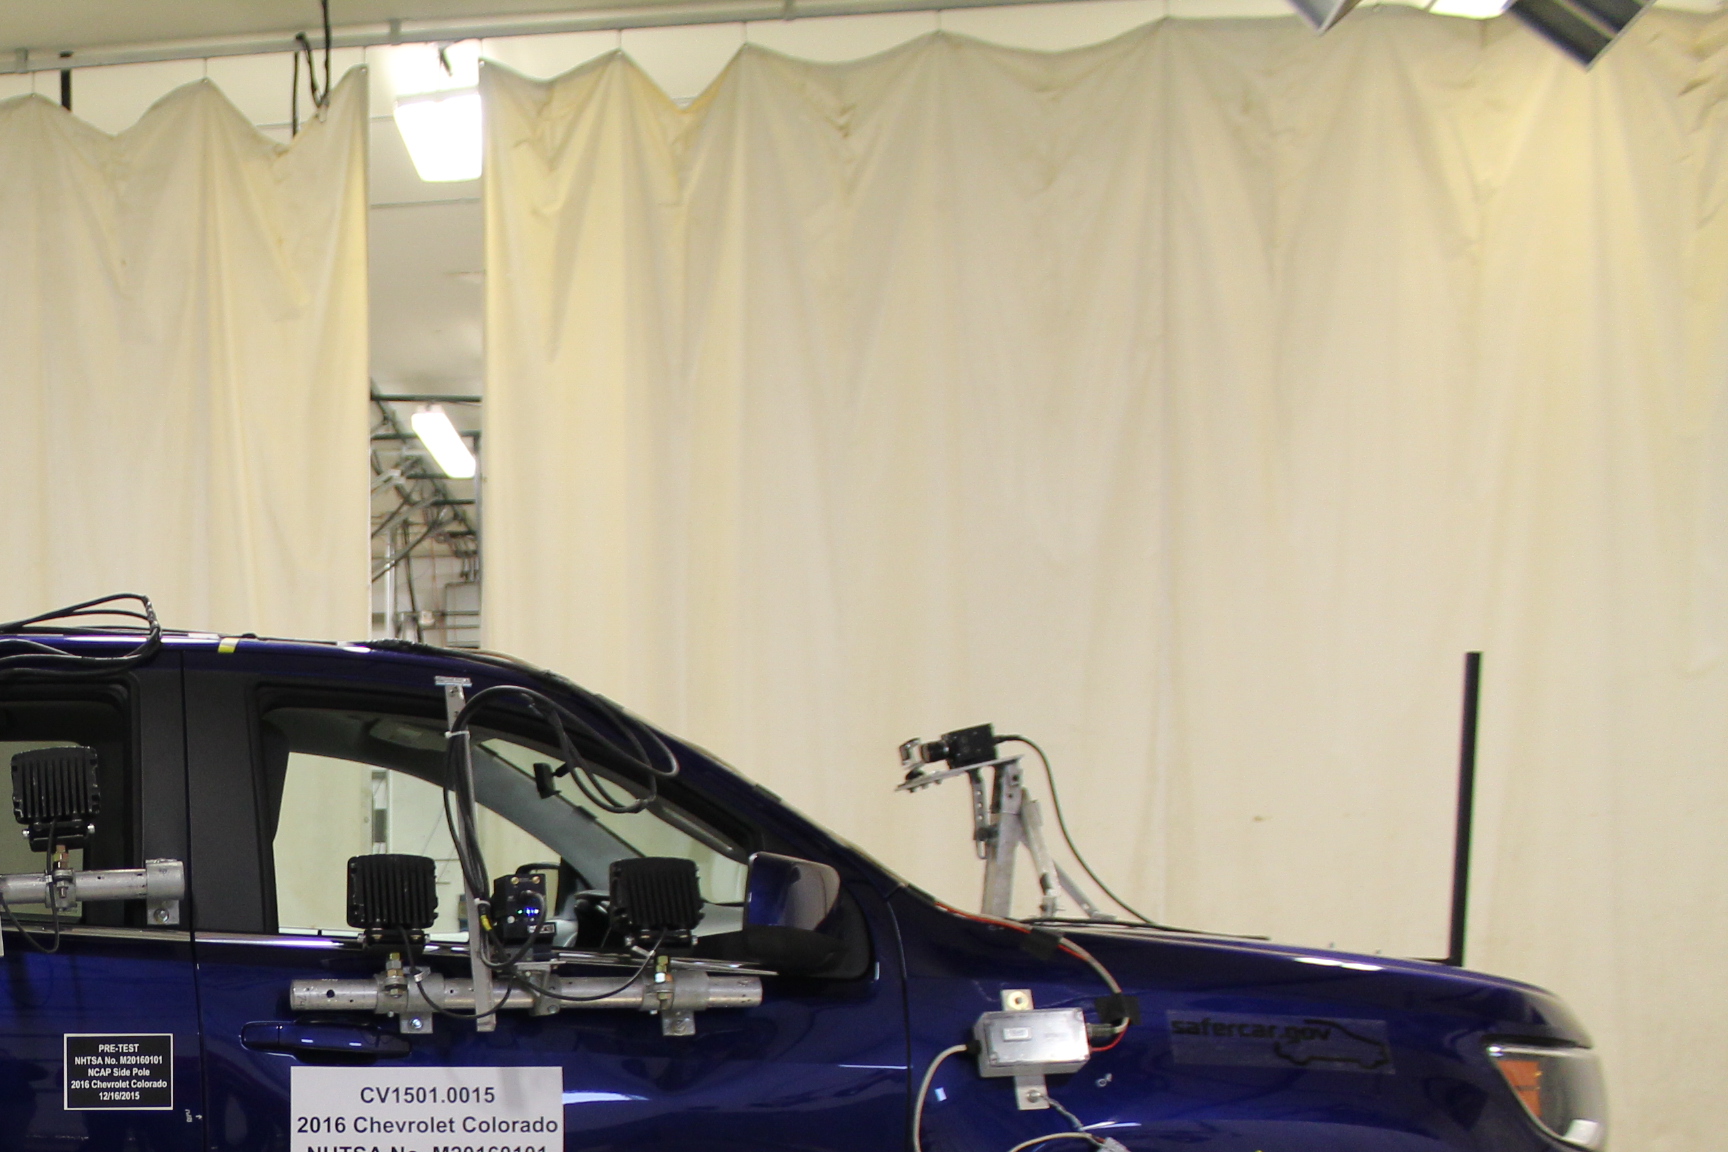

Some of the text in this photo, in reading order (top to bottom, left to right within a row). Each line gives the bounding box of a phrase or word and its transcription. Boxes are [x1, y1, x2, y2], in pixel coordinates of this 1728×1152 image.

[1171, 1017, 1332, 1044] safercar.gov
[98, 1043, 140, 1053] PRE-TEST
[74, 1055, 163, 1065] NHTSA No. M20160101
[87, 1067, 150, 1077] NCAP Side Pole
[70, 1079, 168, 1089] 2016 Chevrolet Colorado
[98, 1091, 140, 1100] 12/16/2015
[359, 1086, 496, 1104] CV1501.0015
[296, 1116, 558, 1134] 2016 Chevrolet Colorado
